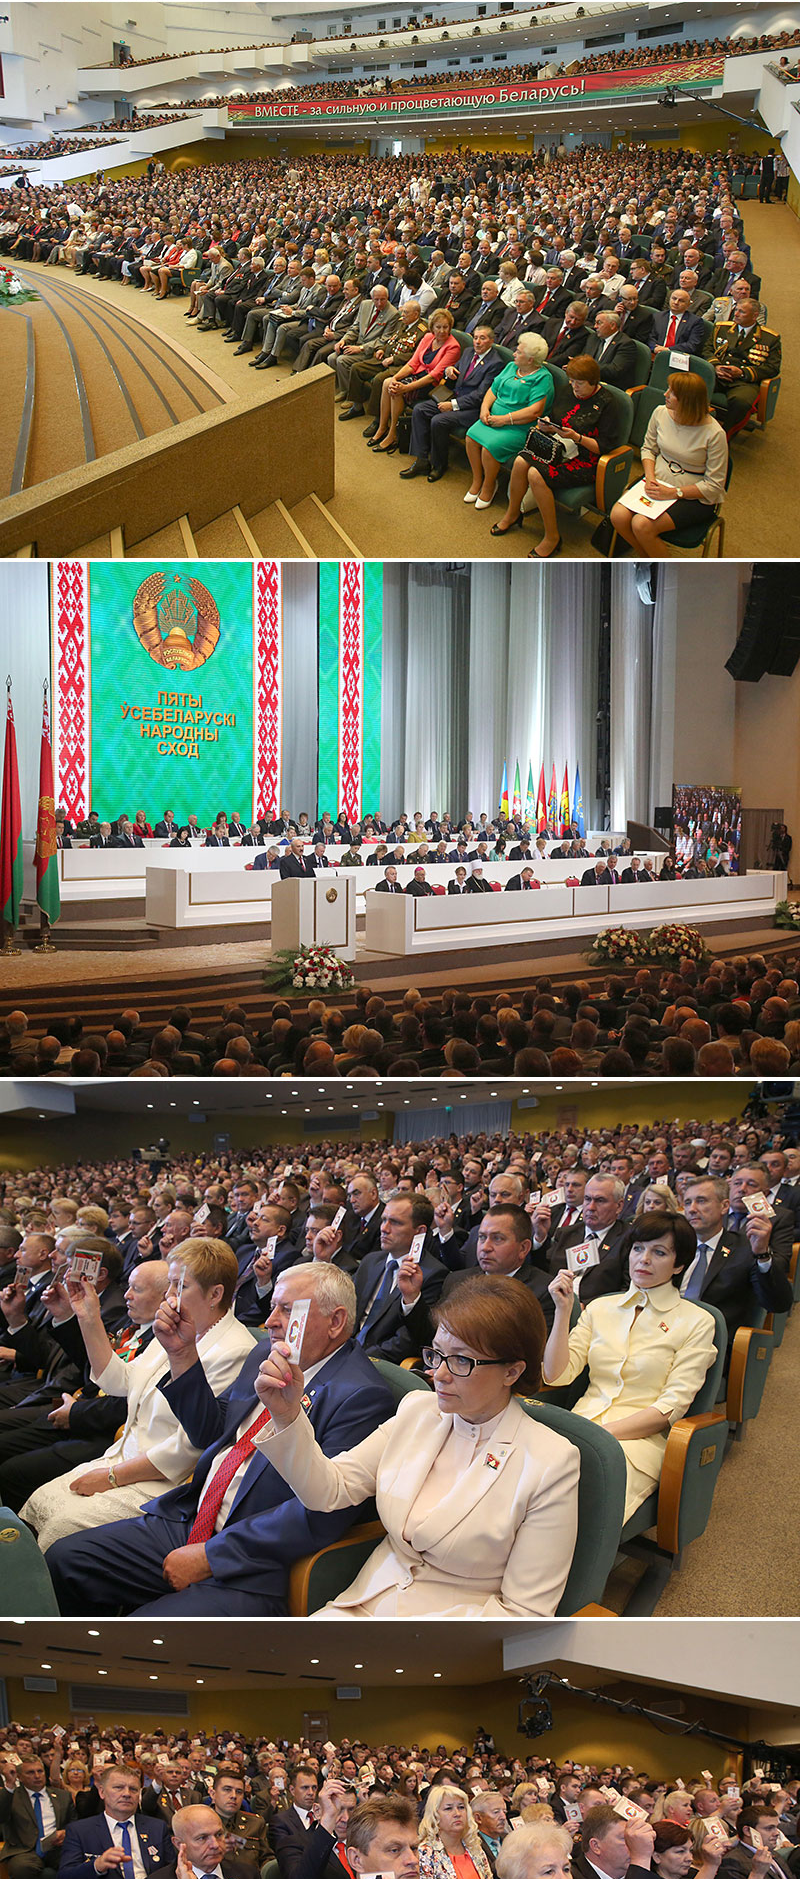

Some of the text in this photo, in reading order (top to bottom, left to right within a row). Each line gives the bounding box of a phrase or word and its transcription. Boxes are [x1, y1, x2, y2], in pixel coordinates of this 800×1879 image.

[255, 105, 300, 118] ВМЕСТЕ
[310, 106, 322, 116] за
[326, 102, 377, 116] сильную
[380, 103, 387, 111] и
[390, 94, 496, 113] процветающую
[500, 80, 586, 103] Беларусь!
[158, 691, 202, 708] ПЯТЫ
[120, 701, 236, 726] ЎСЕБЕЛАРУСКІ
[140, 723, 218, 742] НАРОДНЫ
[157, 741, 200, 759] СХОД
